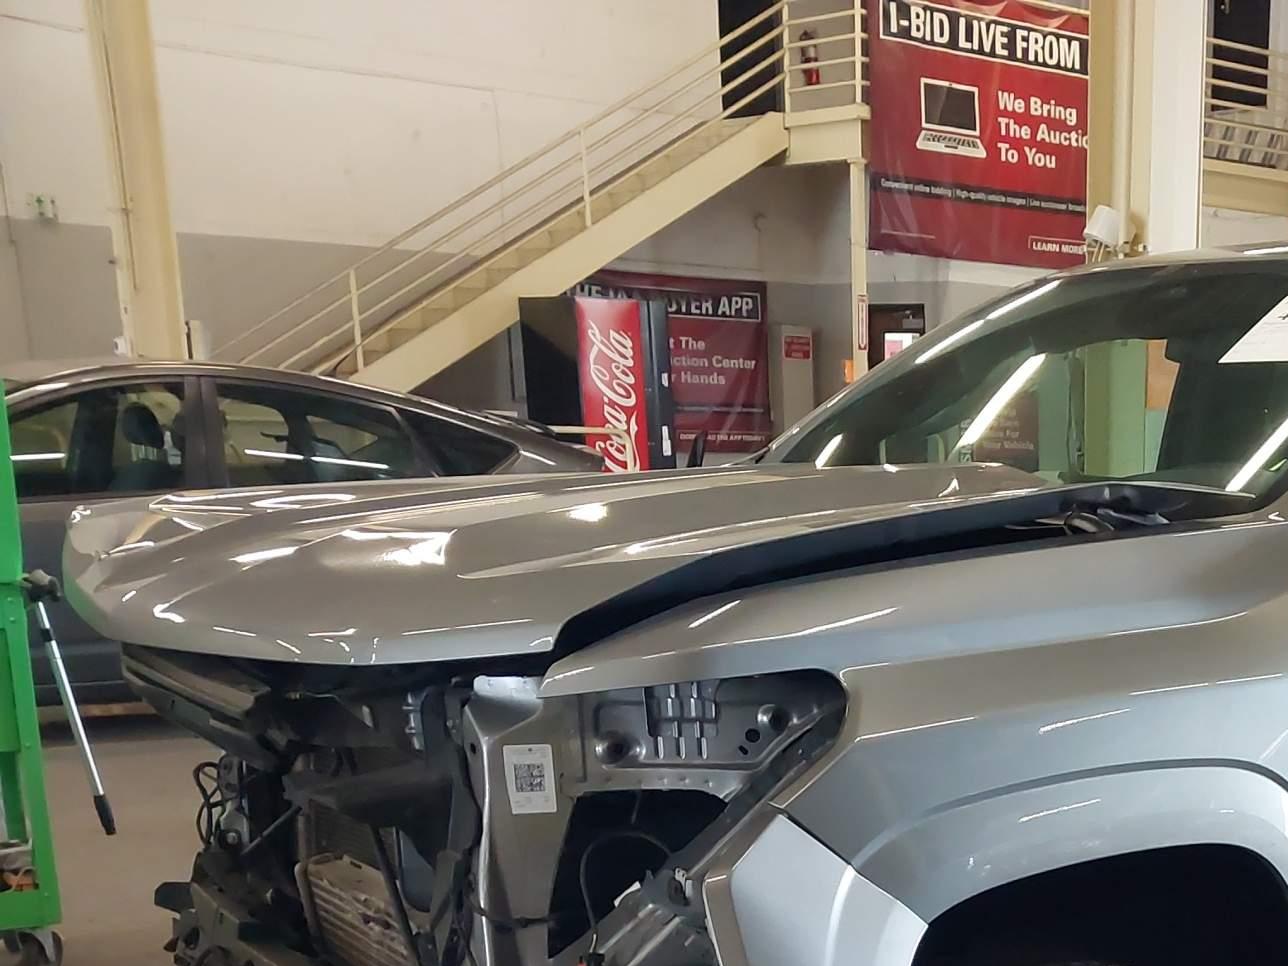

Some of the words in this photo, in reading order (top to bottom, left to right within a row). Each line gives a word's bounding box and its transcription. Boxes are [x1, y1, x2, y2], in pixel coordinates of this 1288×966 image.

[889, 2, 950, 44] I-BID
[959, 17, 1008, 57] LIVE
[1016, 28, 1080, 70] FROM
[998, 90, 1025, 113] We
[1030, 96, 1077, 126] Bring
[998, 117, 1031, 140] The
[997, 143, 1018, 164] To
[1024, 147, 1055, 169] You
[1033, 242, 1059, 252] LEARN
[717, 295, 753, 317] APP
[679, 336, 705, 350] The
[670, 355, 708, 367] ction
[712, 355, 756, 369] Center
[681, 371, 726, 385] Hands
